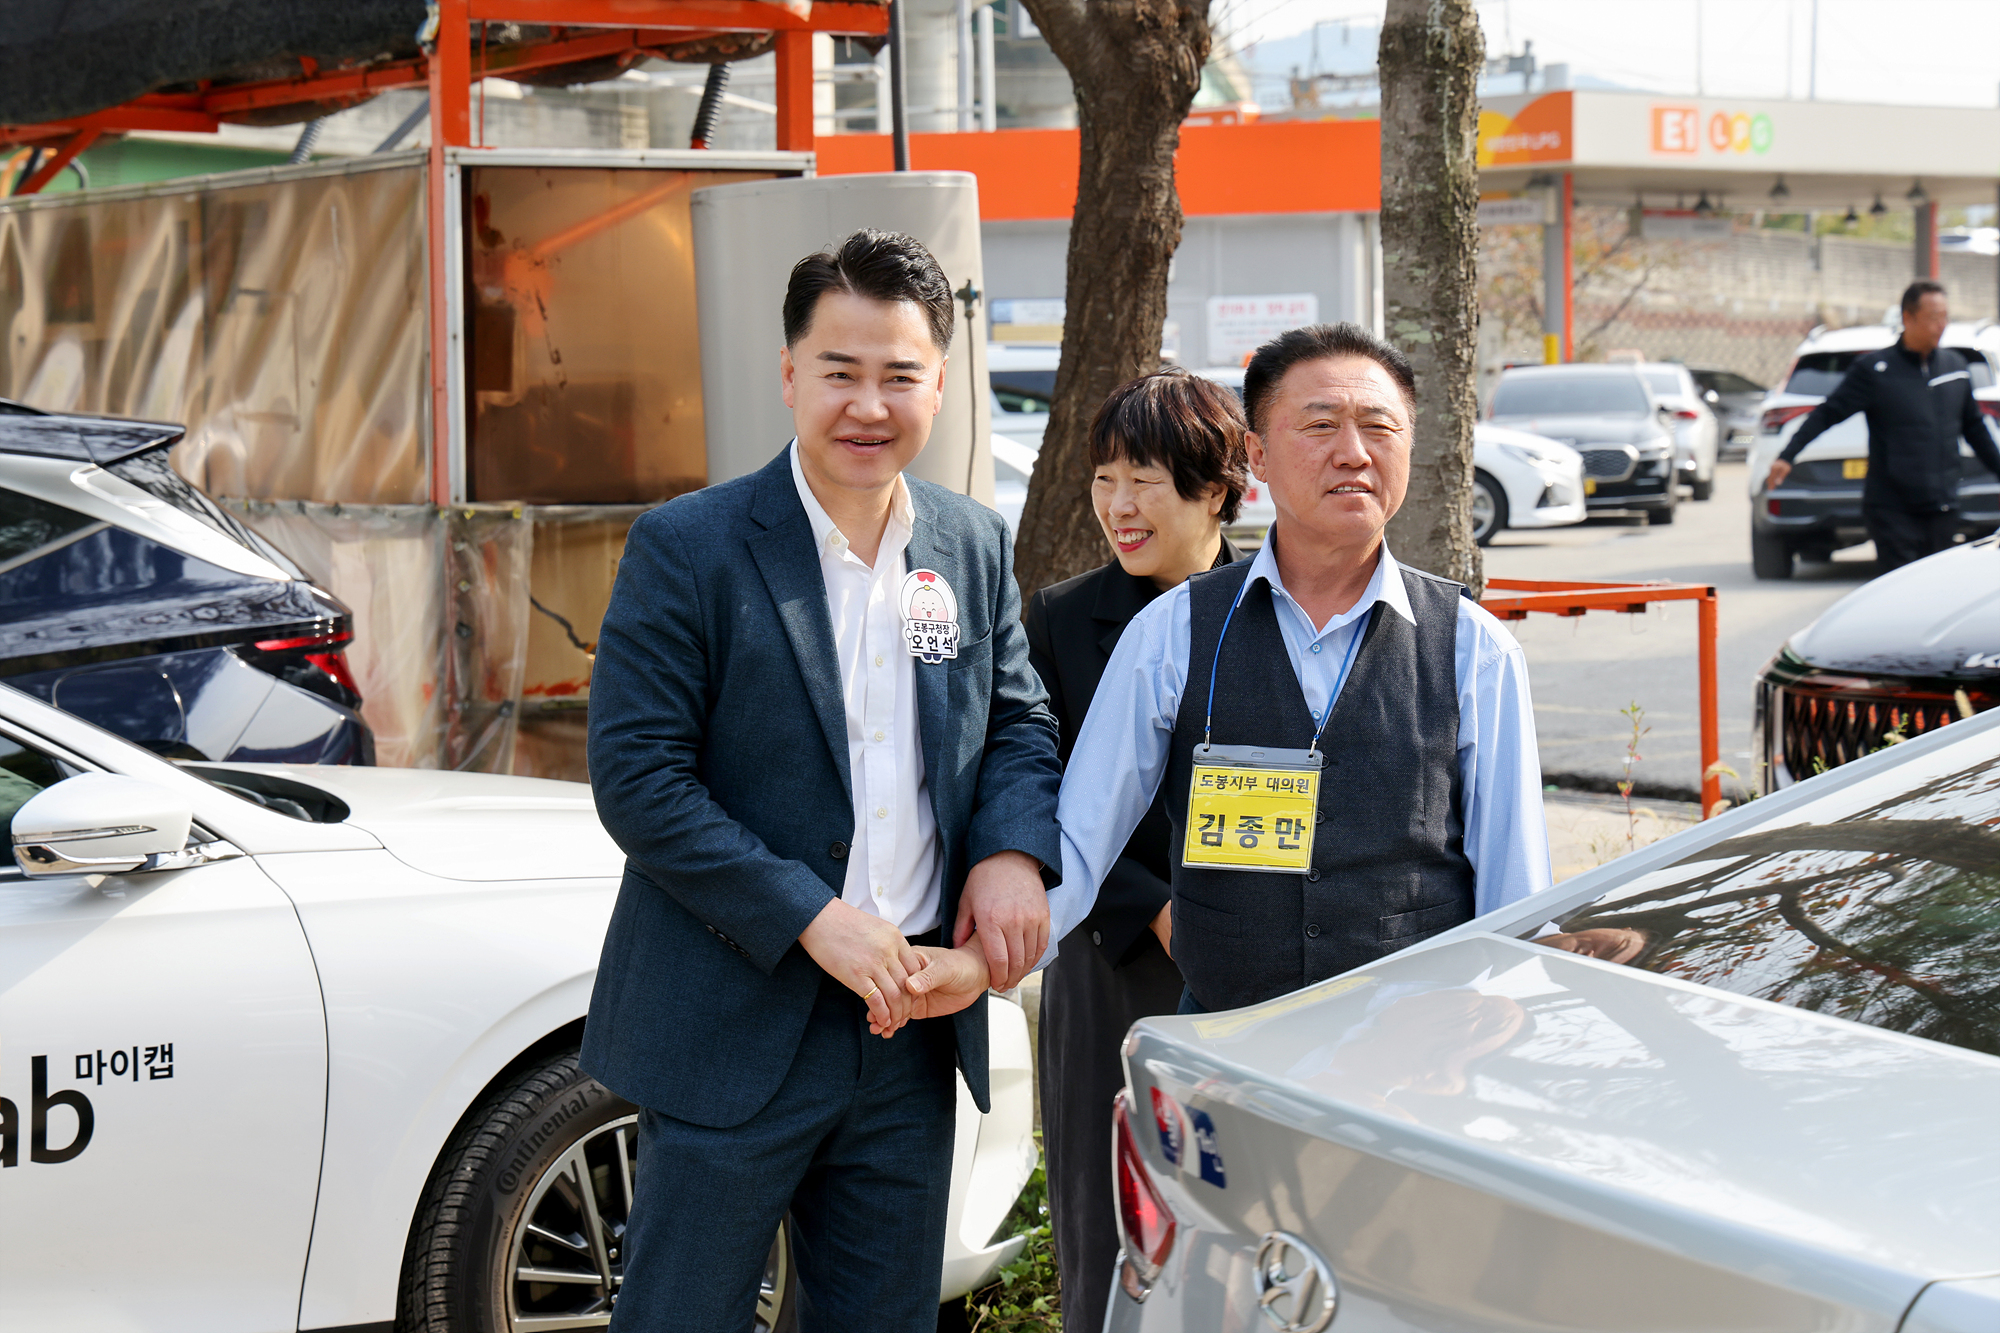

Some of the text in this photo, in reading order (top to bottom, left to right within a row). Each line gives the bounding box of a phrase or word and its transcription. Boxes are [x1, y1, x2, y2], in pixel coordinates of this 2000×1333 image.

[1660, 109, 1771, 151] E1 LPG
[914, 622, 950, 635] 도봉구청장
[1200, 774, 1310, 794] 도봉지부 대의원
[75, 1042, 174, 1086] 마이캡
[496, 1090, 590, 1196] Continental
